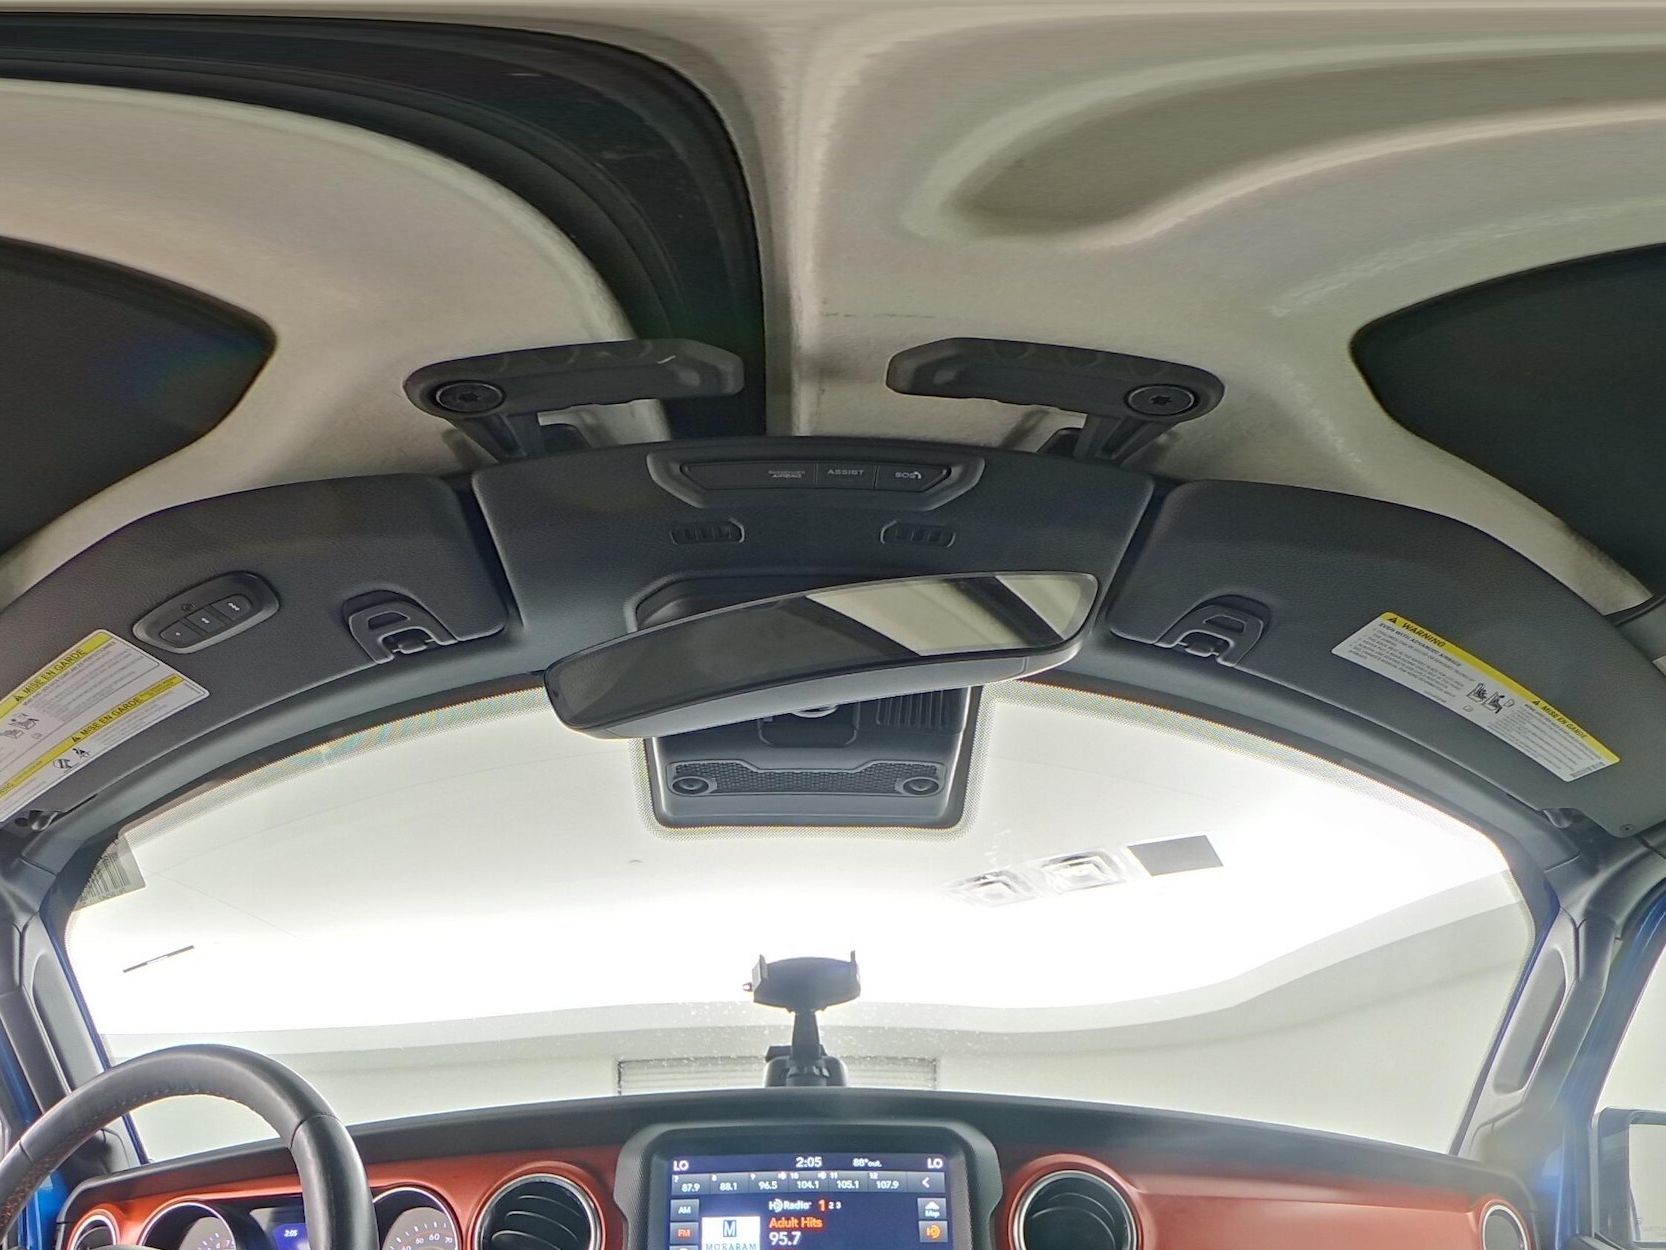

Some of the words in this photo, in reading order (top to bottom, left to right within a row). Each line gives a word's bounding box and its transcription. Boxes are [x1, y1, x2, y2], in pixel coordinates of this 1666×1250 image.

[1402, 622, 1447, 648] WARNING
[22, 679, 44, 694] MISE
[41, 670, 56, 680] EN
[54, 649, 85, 671] GARDE
[80, 722, 100, 736] MISE
[99, 715, 112, 724] EN
[111, 698, 141, 717] GARDE
[673, 1160, 689, 1172] LO
[795, 1156, 823, 1168] 2:05
[927, 1158, 943, 1169] LO
[681, 1183, 701, 1192] 87.9
[719, 1182, 737, 1191] 88.1
[759, 1180, 778, 1190] 96.5
[797, 1180, 819, 1189] 104.1
[837, 1180, 859, 1188] 105.1
[877, 1180, 899, 1190] 107.9
[678, 1206, 691, 1214] AM
[819, 1200, 825, 1212] 1
[769, 1217, 799, 1229] Adult
[801, 1217, 823, 1228] Hits
[677, 1229, 691, 1237] FM
[769, 1232, 801, 1246] 95.7
